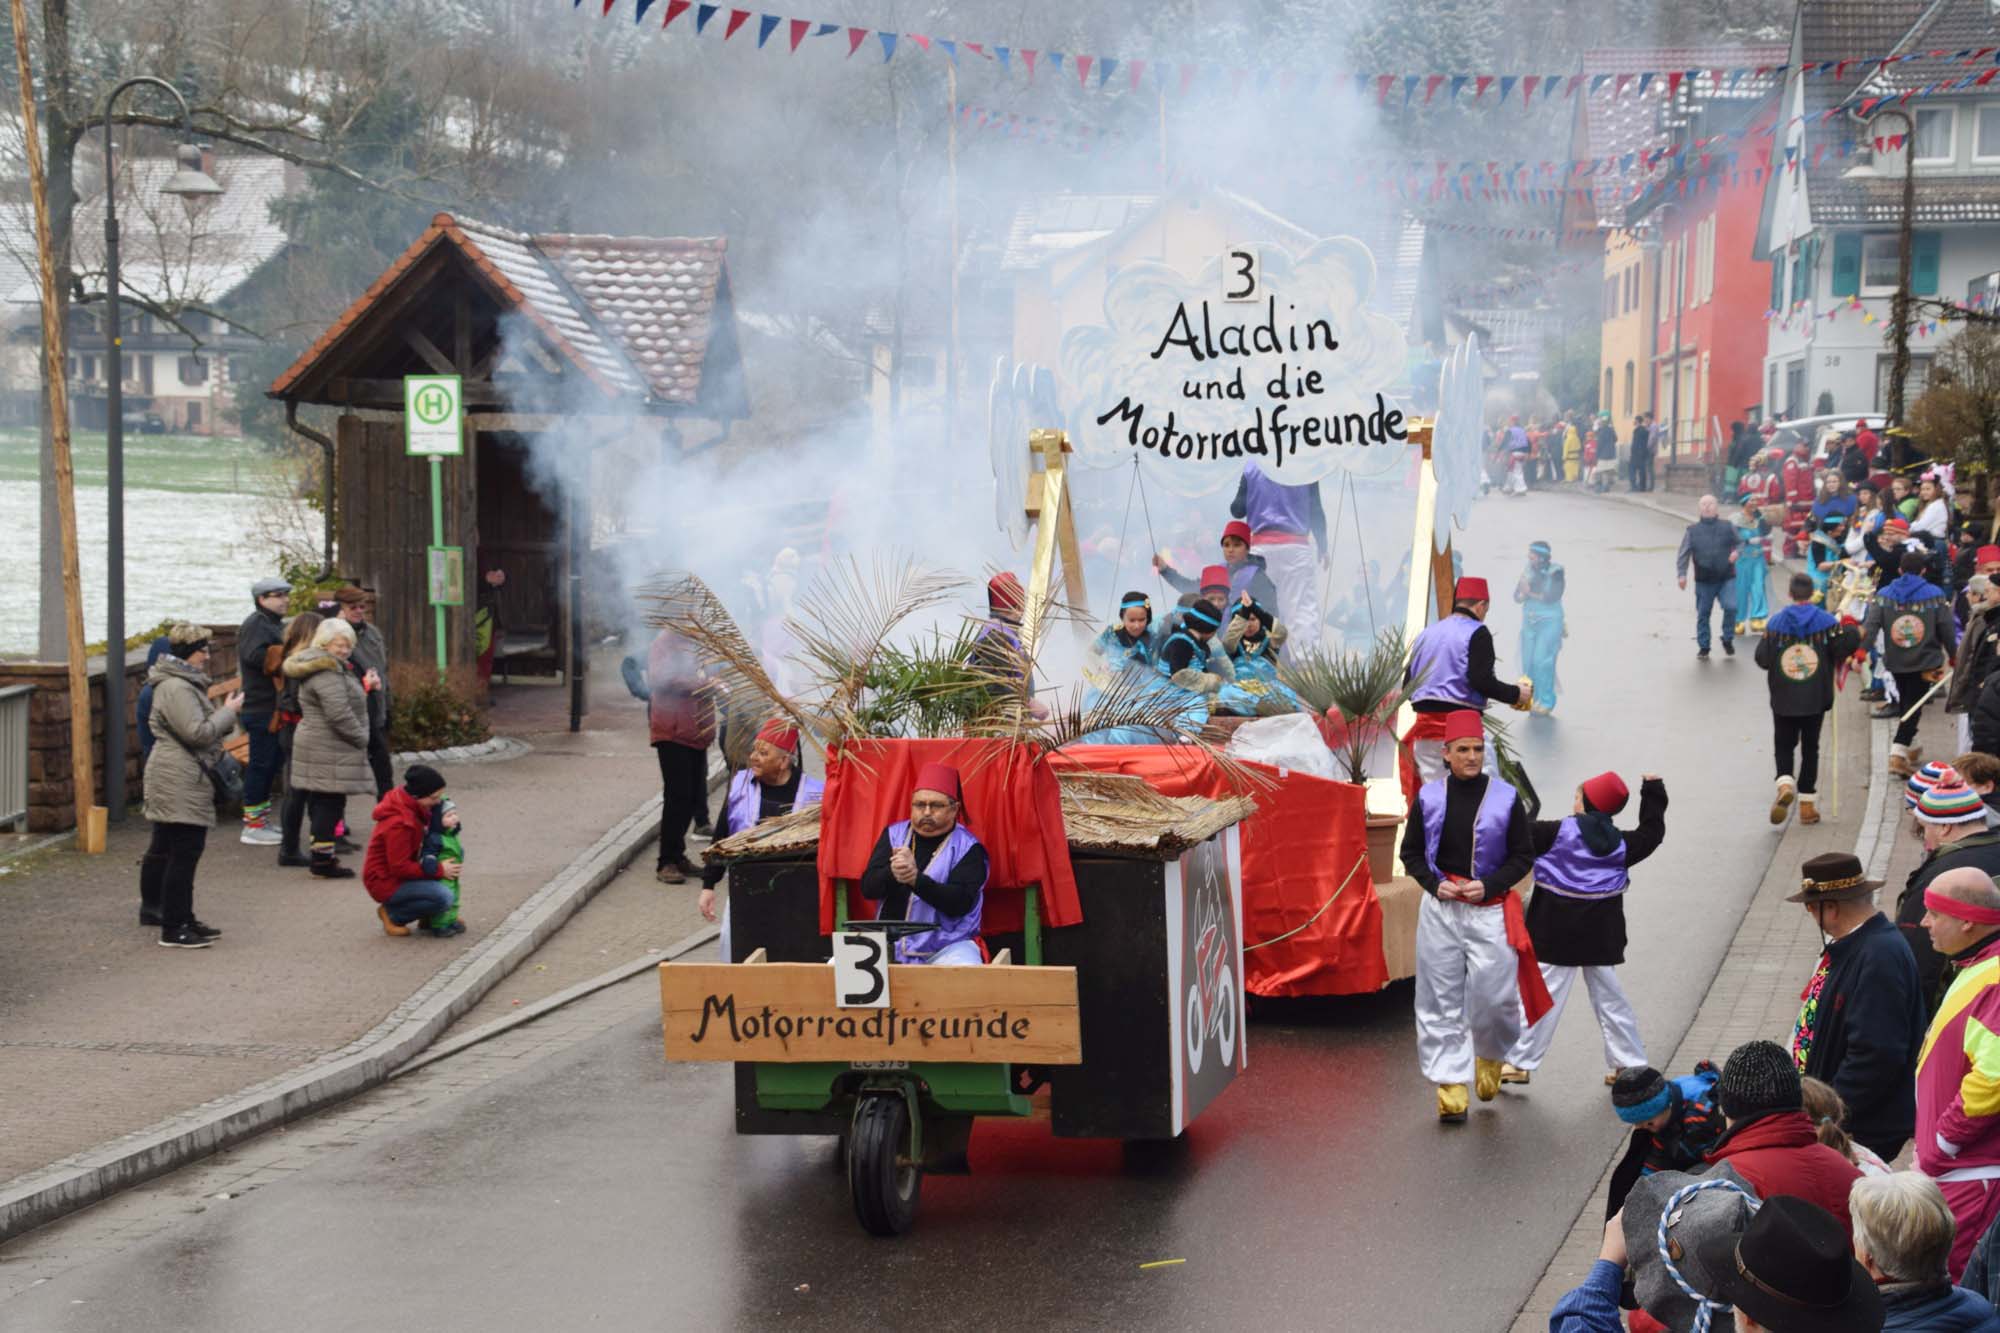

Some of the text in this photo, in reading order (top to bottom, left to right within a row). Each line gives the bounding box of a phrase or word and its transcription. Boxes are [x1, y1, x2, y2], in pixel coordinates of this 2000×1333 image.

[1227, 251, 1255, 299] 3
[1151, 295, 1338, 361] Aladin
[425, 394, 443, 415] H
[1183, 363, 1324, 400] und die
[1097, 393, 1408, 467] Motorradfreunde
[843, 936, 884, 1005] 3
[691, 994, 1030, 1045] Motorradfreunde
